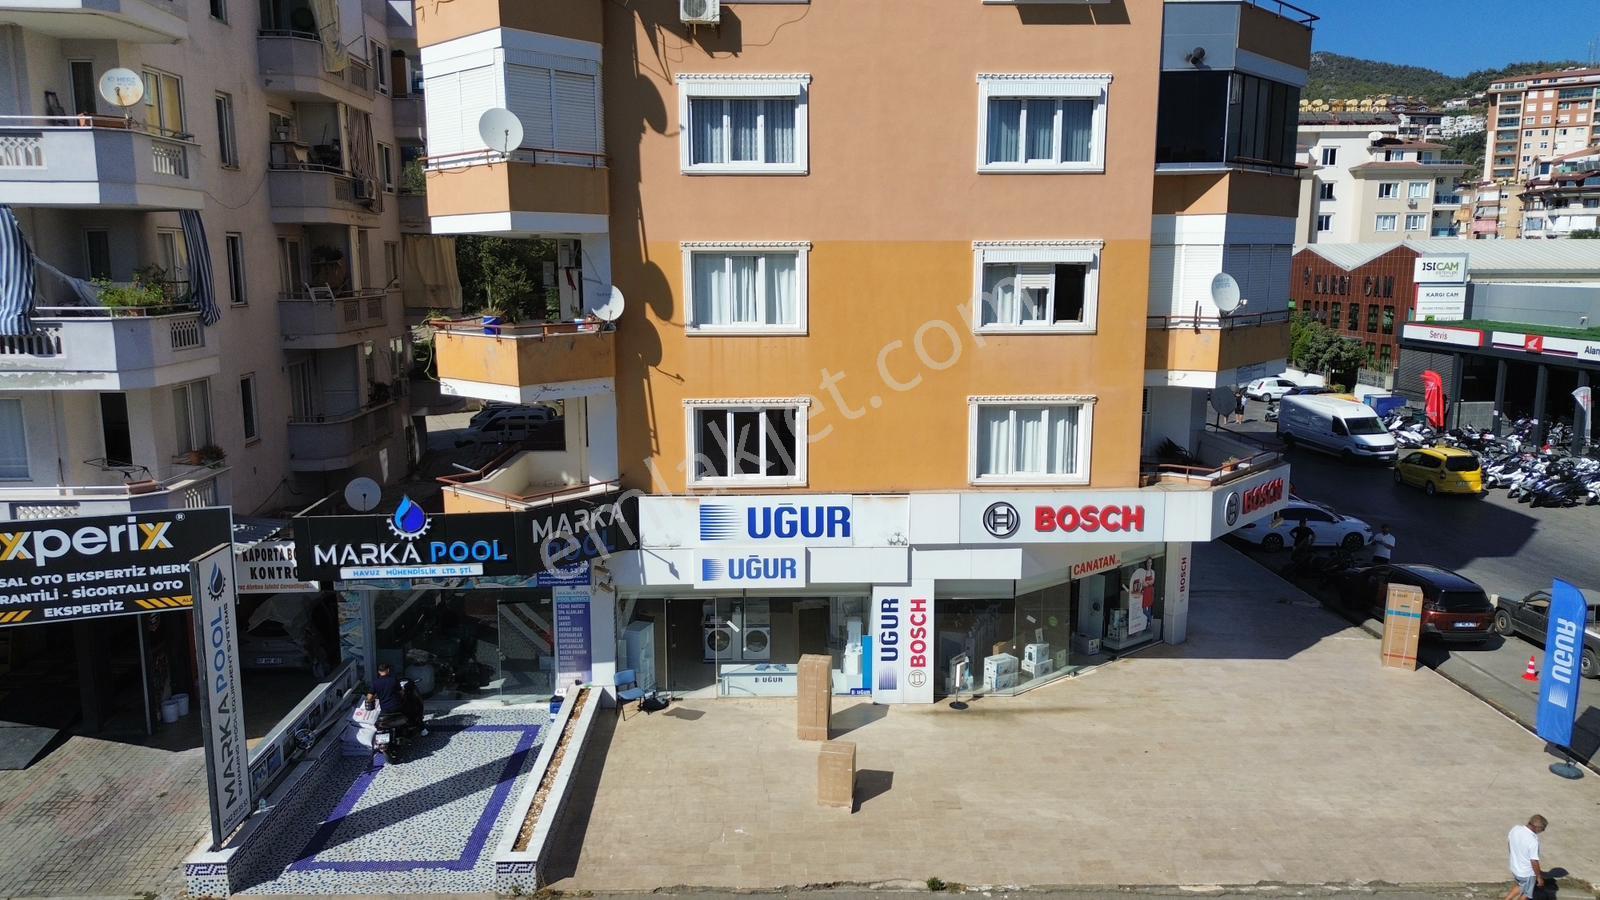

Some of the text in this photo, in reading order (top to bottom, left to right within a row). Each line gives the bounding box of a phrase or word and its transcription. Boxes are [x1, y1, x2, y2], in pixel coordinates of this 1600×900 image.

[1429, 330, 1448, 340] Servis
[1242, 479, 1284, 515] BOSCH
[532, 502, 625, 543] MARKA
[748, 503, 851, 539] UĞUR
[1035, 505, 1145, 532] BOSCH
[0, 516, 174, 567] xperix
[313, 540, 508, 565] MARKA POOL
[242, 548, 285, 562] KAPORTA
[728, 555, 797, 580] UĞUR
[1073, 554, 1116, 576] CANATAN
[31, 575, 63, 586] OTO
[67, 565, 147, 583] EKSPERTİZ
[353, 569, 380, 577] HAVUZ
[386, 567, 437, 576] MÜHENDİSLİK
[72, 583, 149, 599] SİGORTALI
[153, 580, 183, 592] OTO
[44, 599, 125, 618] EKSPERTİZ
[223, 603, 232, 652] SYSTEMS
[879, 598, 899, 661] UĞUR
[910, 599, 927, 667] BOSCH
